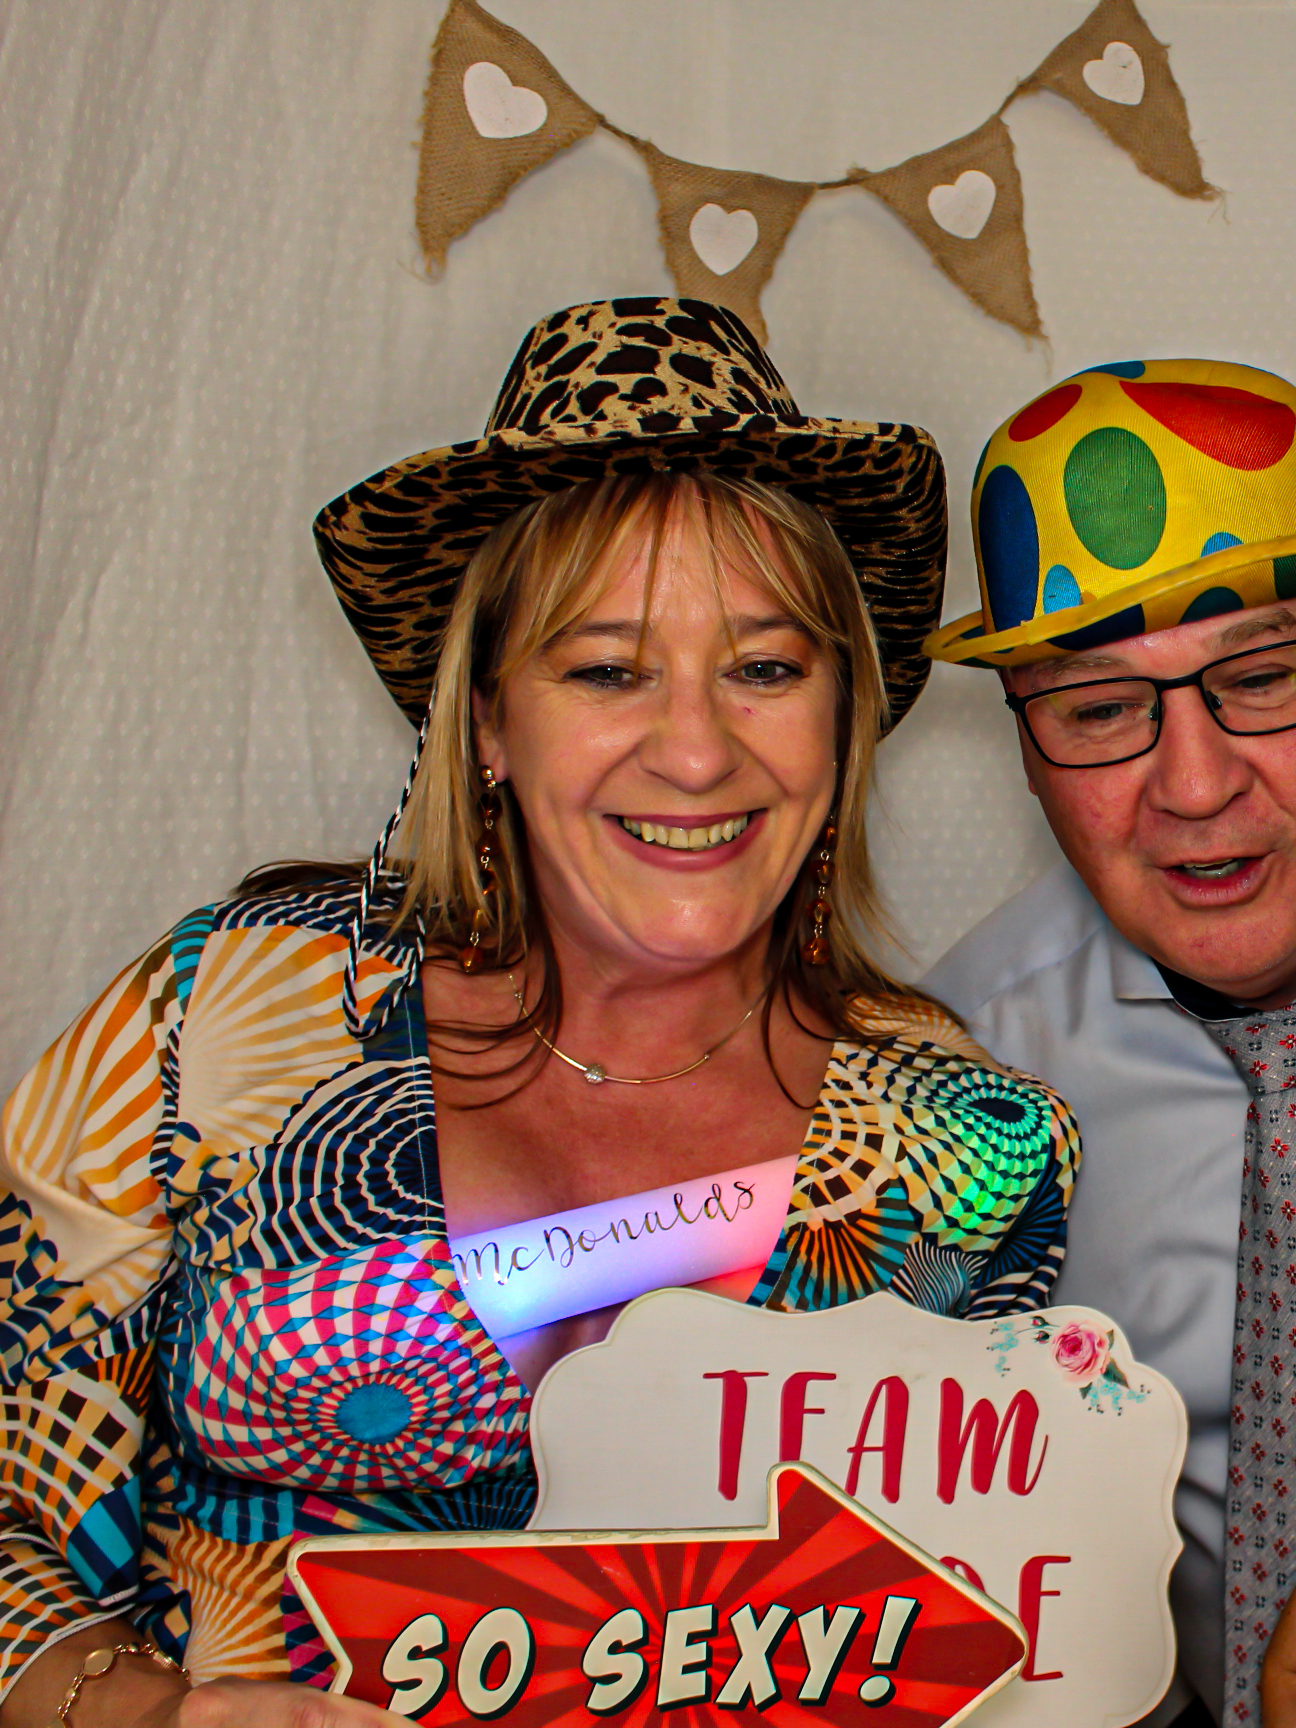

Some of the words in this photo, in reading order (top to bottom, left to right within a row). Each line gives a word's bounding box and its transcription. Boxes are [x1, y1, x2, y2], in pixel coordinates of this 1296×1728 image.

[451, 1180, 756, 1286] McDonalds
[702, 1369, 1049, 1505] TEAM
[380, 1606, 536, 1721] SO
[580, 1594, 922, 1717] SEXY!
